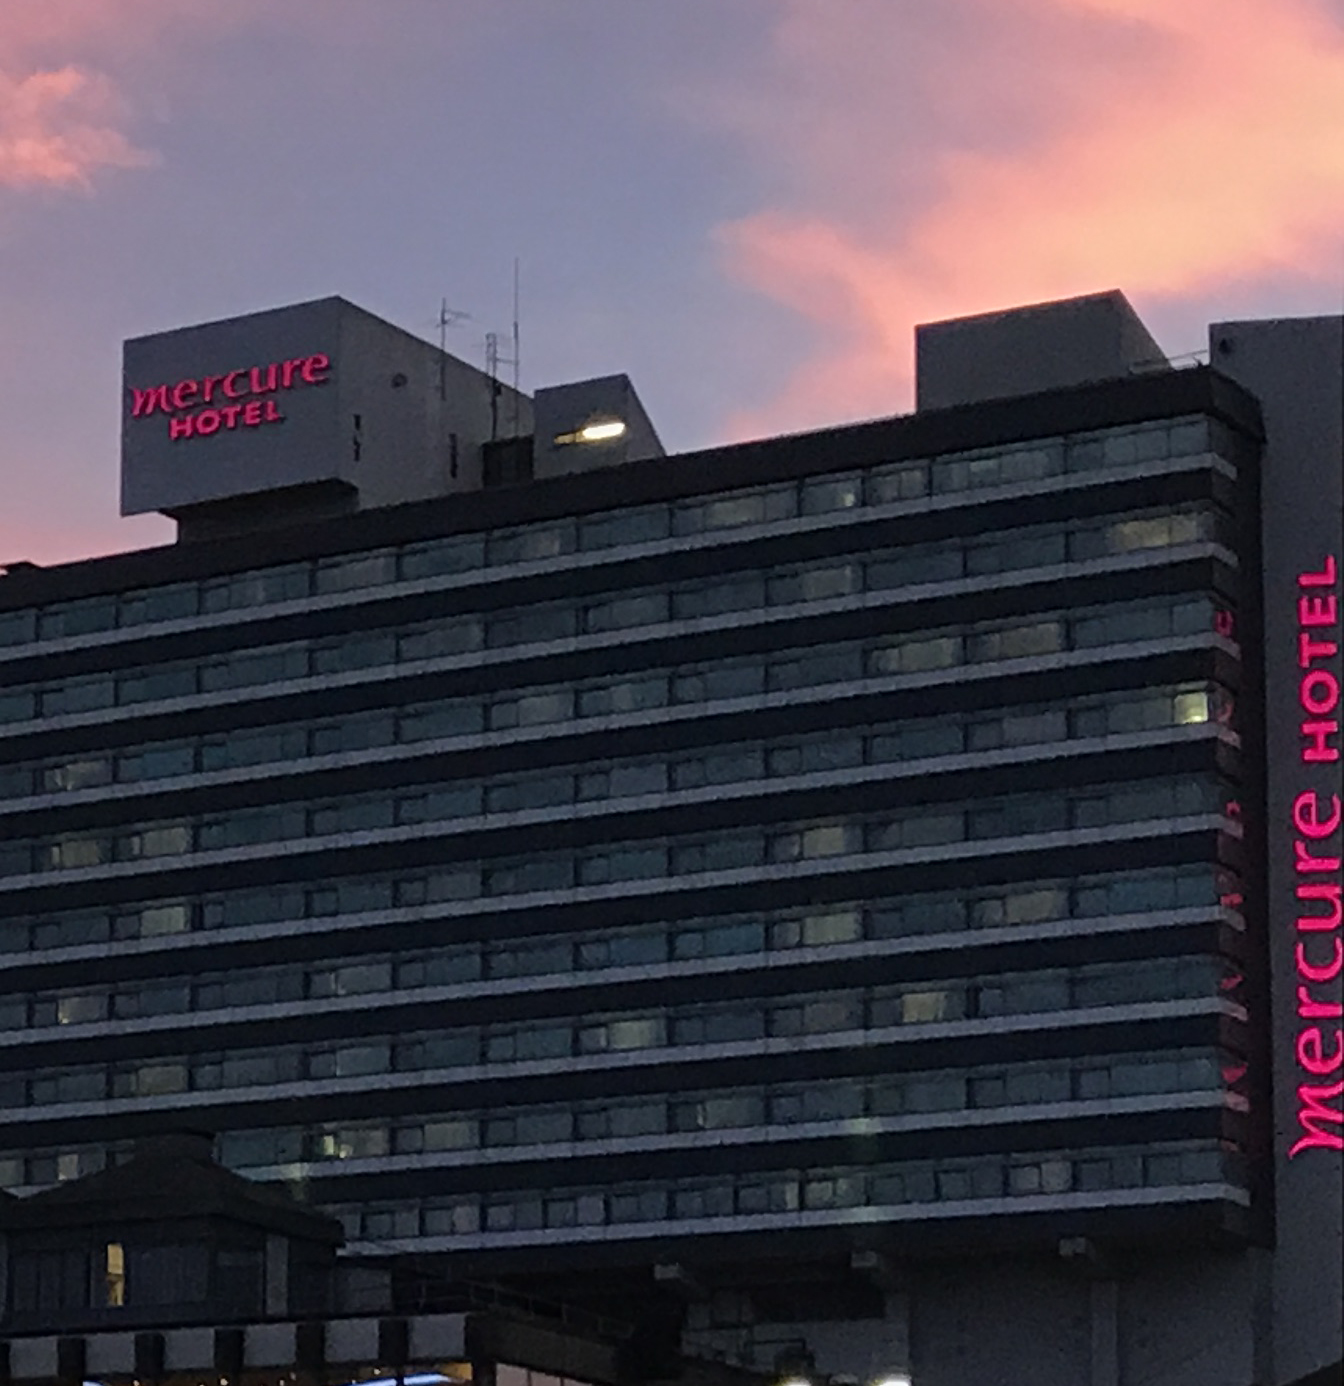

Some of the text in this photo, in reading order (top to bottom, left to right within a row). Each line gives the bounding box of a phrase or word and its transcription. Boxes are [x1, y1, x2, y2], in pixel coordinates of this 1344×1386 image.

[128, 352, 330, 418] mercure
[168, 400, 282, 440] HOTEL
[1288, 554, 1344, 1162] mercure HOTEL
